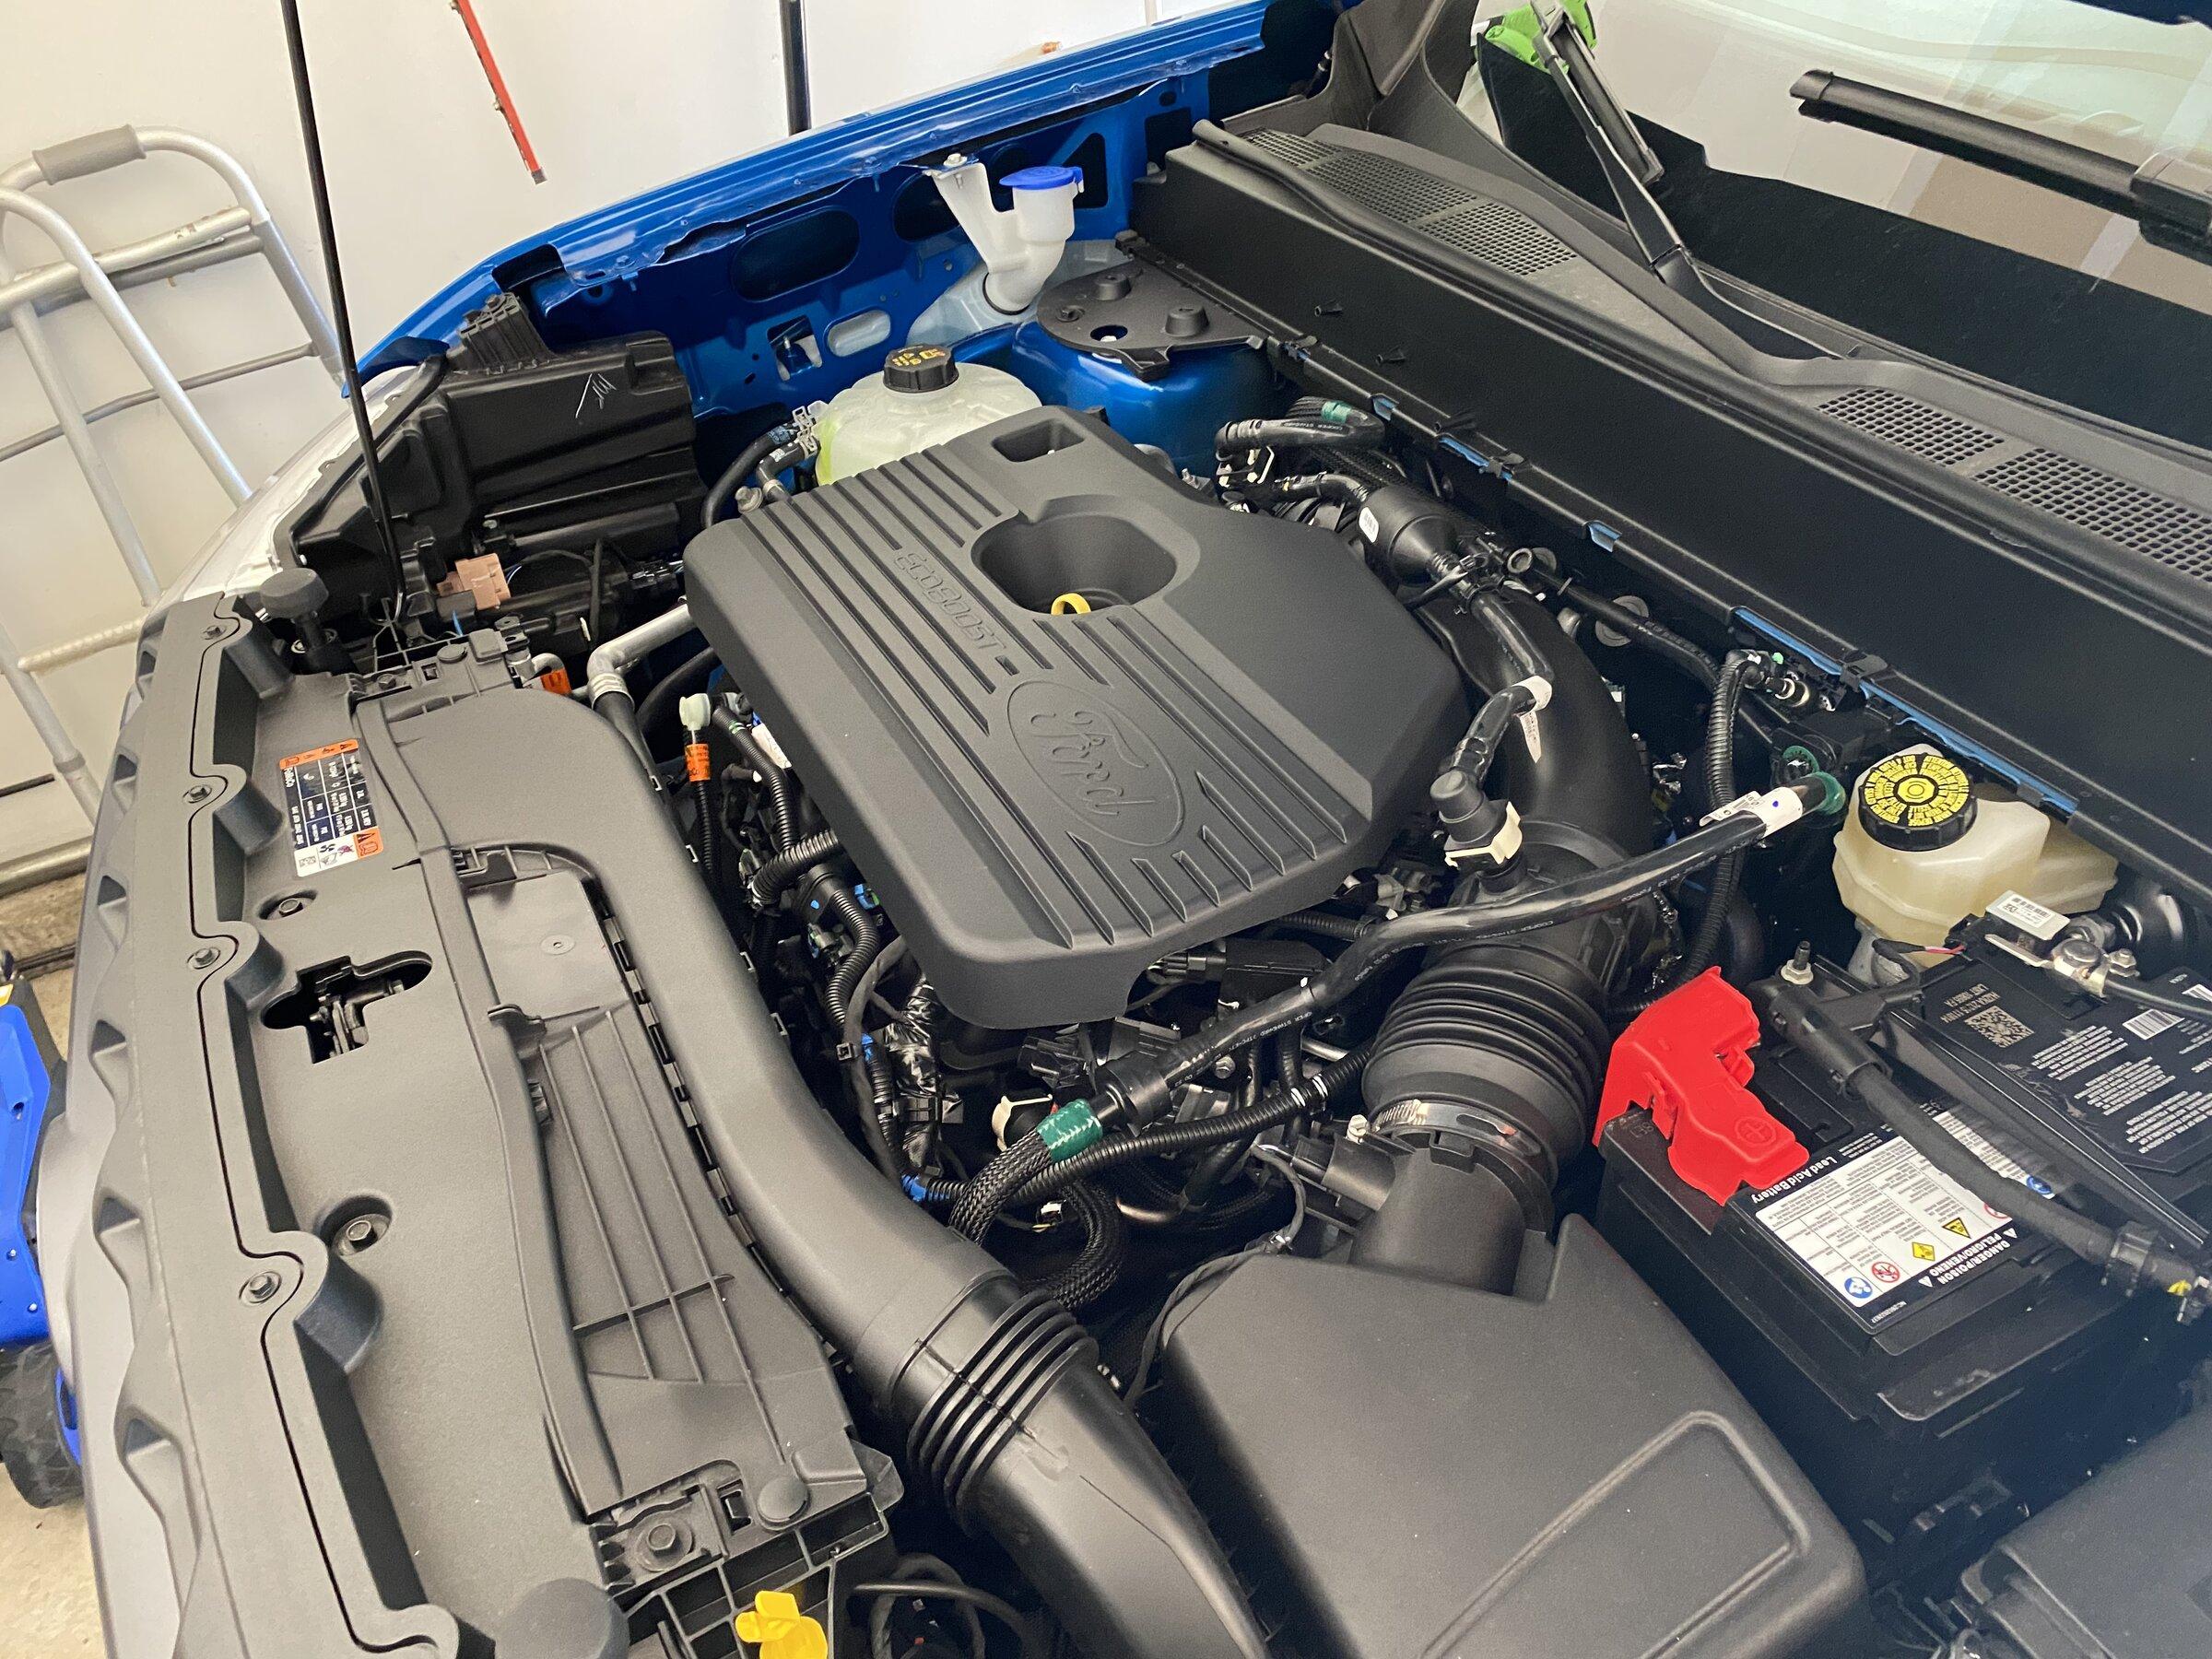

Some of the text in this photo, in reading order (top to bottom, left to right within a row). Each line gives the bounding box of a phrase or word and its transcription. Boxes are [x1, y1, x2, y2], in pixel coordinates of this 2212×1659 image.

[1030, 711, 1156, 817] Ford
[1786, 1168, 1813, 1186] Acid
[1808, 1155, 1838, 1174] Lead
[1751, 1181, 1791, 1204] Battery
[1927, 1231, 2002, 1277] PELIGRO/VENENO
[1936, 1240, 2010, 1285] DANGER/POISON
